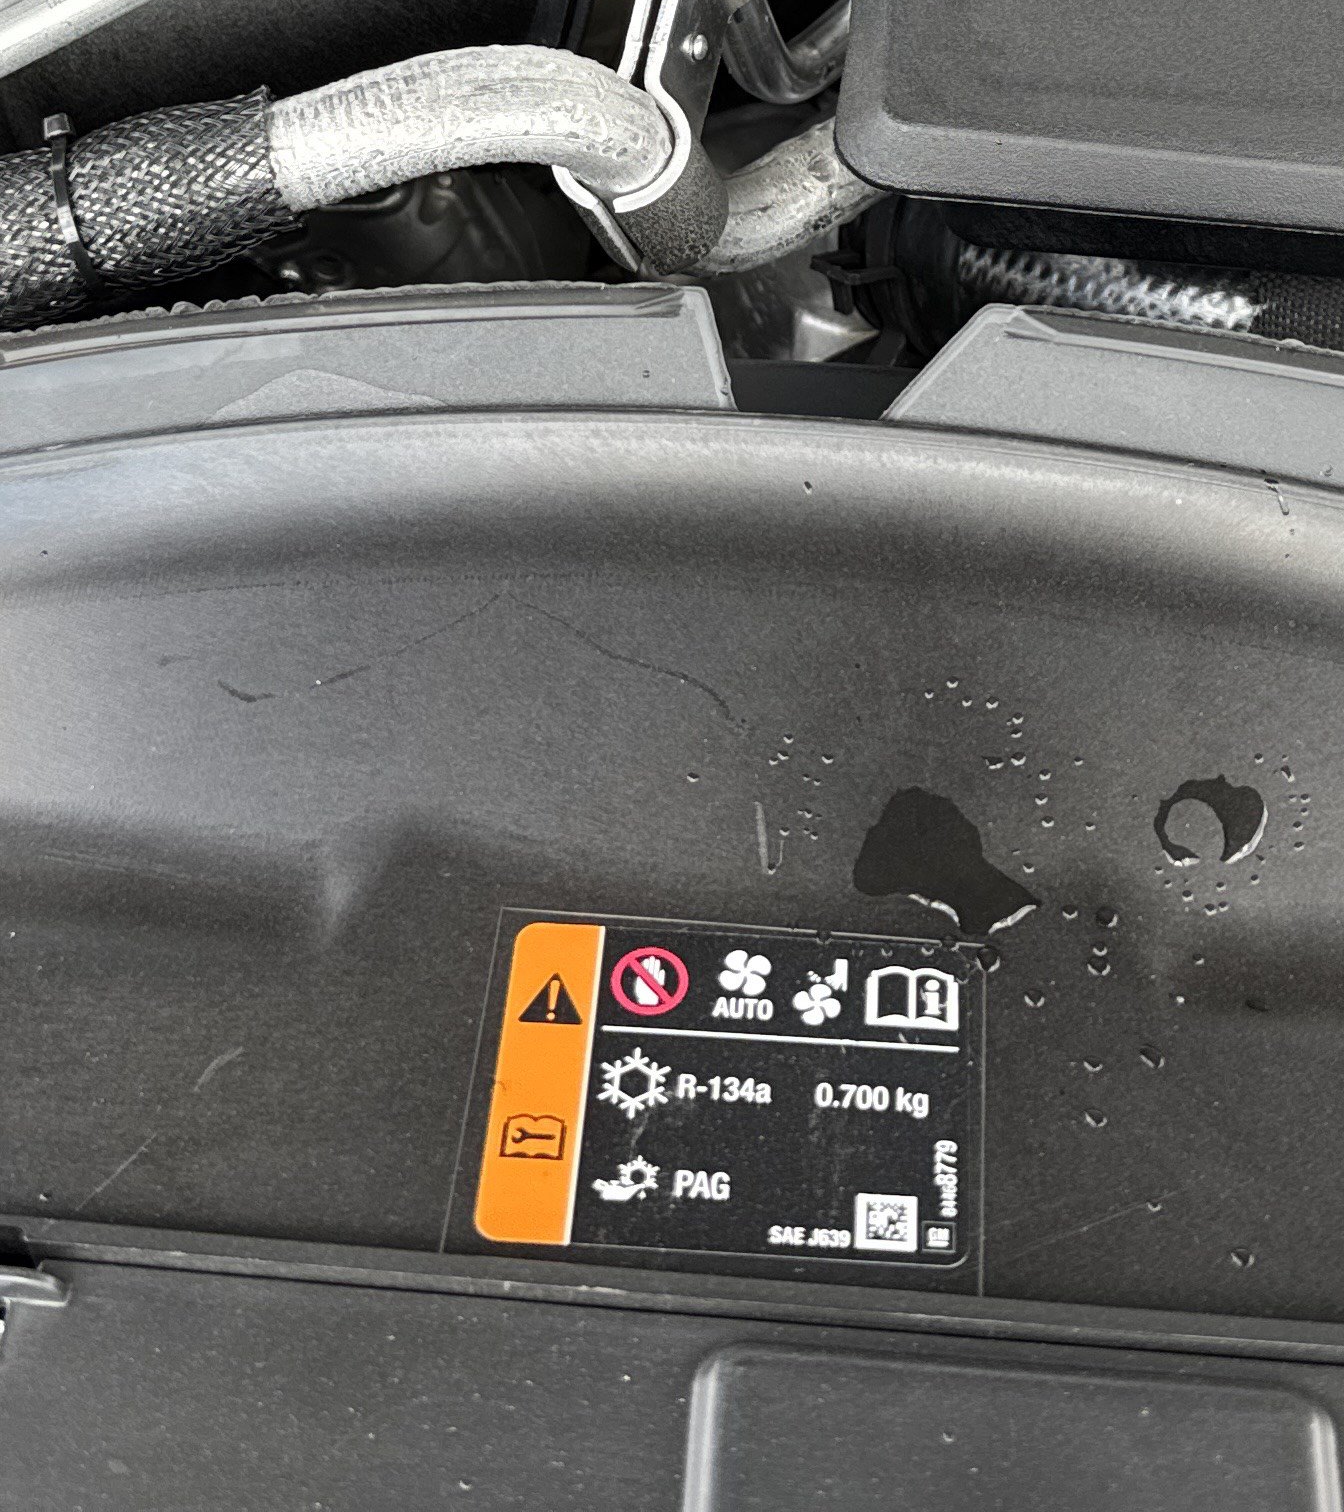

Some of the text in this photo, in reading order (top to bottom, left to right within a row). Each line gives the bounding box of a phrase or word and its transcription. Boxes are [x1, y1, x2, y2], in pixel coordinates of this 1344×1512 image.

[712, 996, 774, 1022] AUTO
[677, 1073, 930, 1118] R-134a 0.700 kg
[674, 1170, 731, 1200] PAG
[768, 1225, 851, 1248] SAE J639
[928, 1226, 951, 1248] GM
